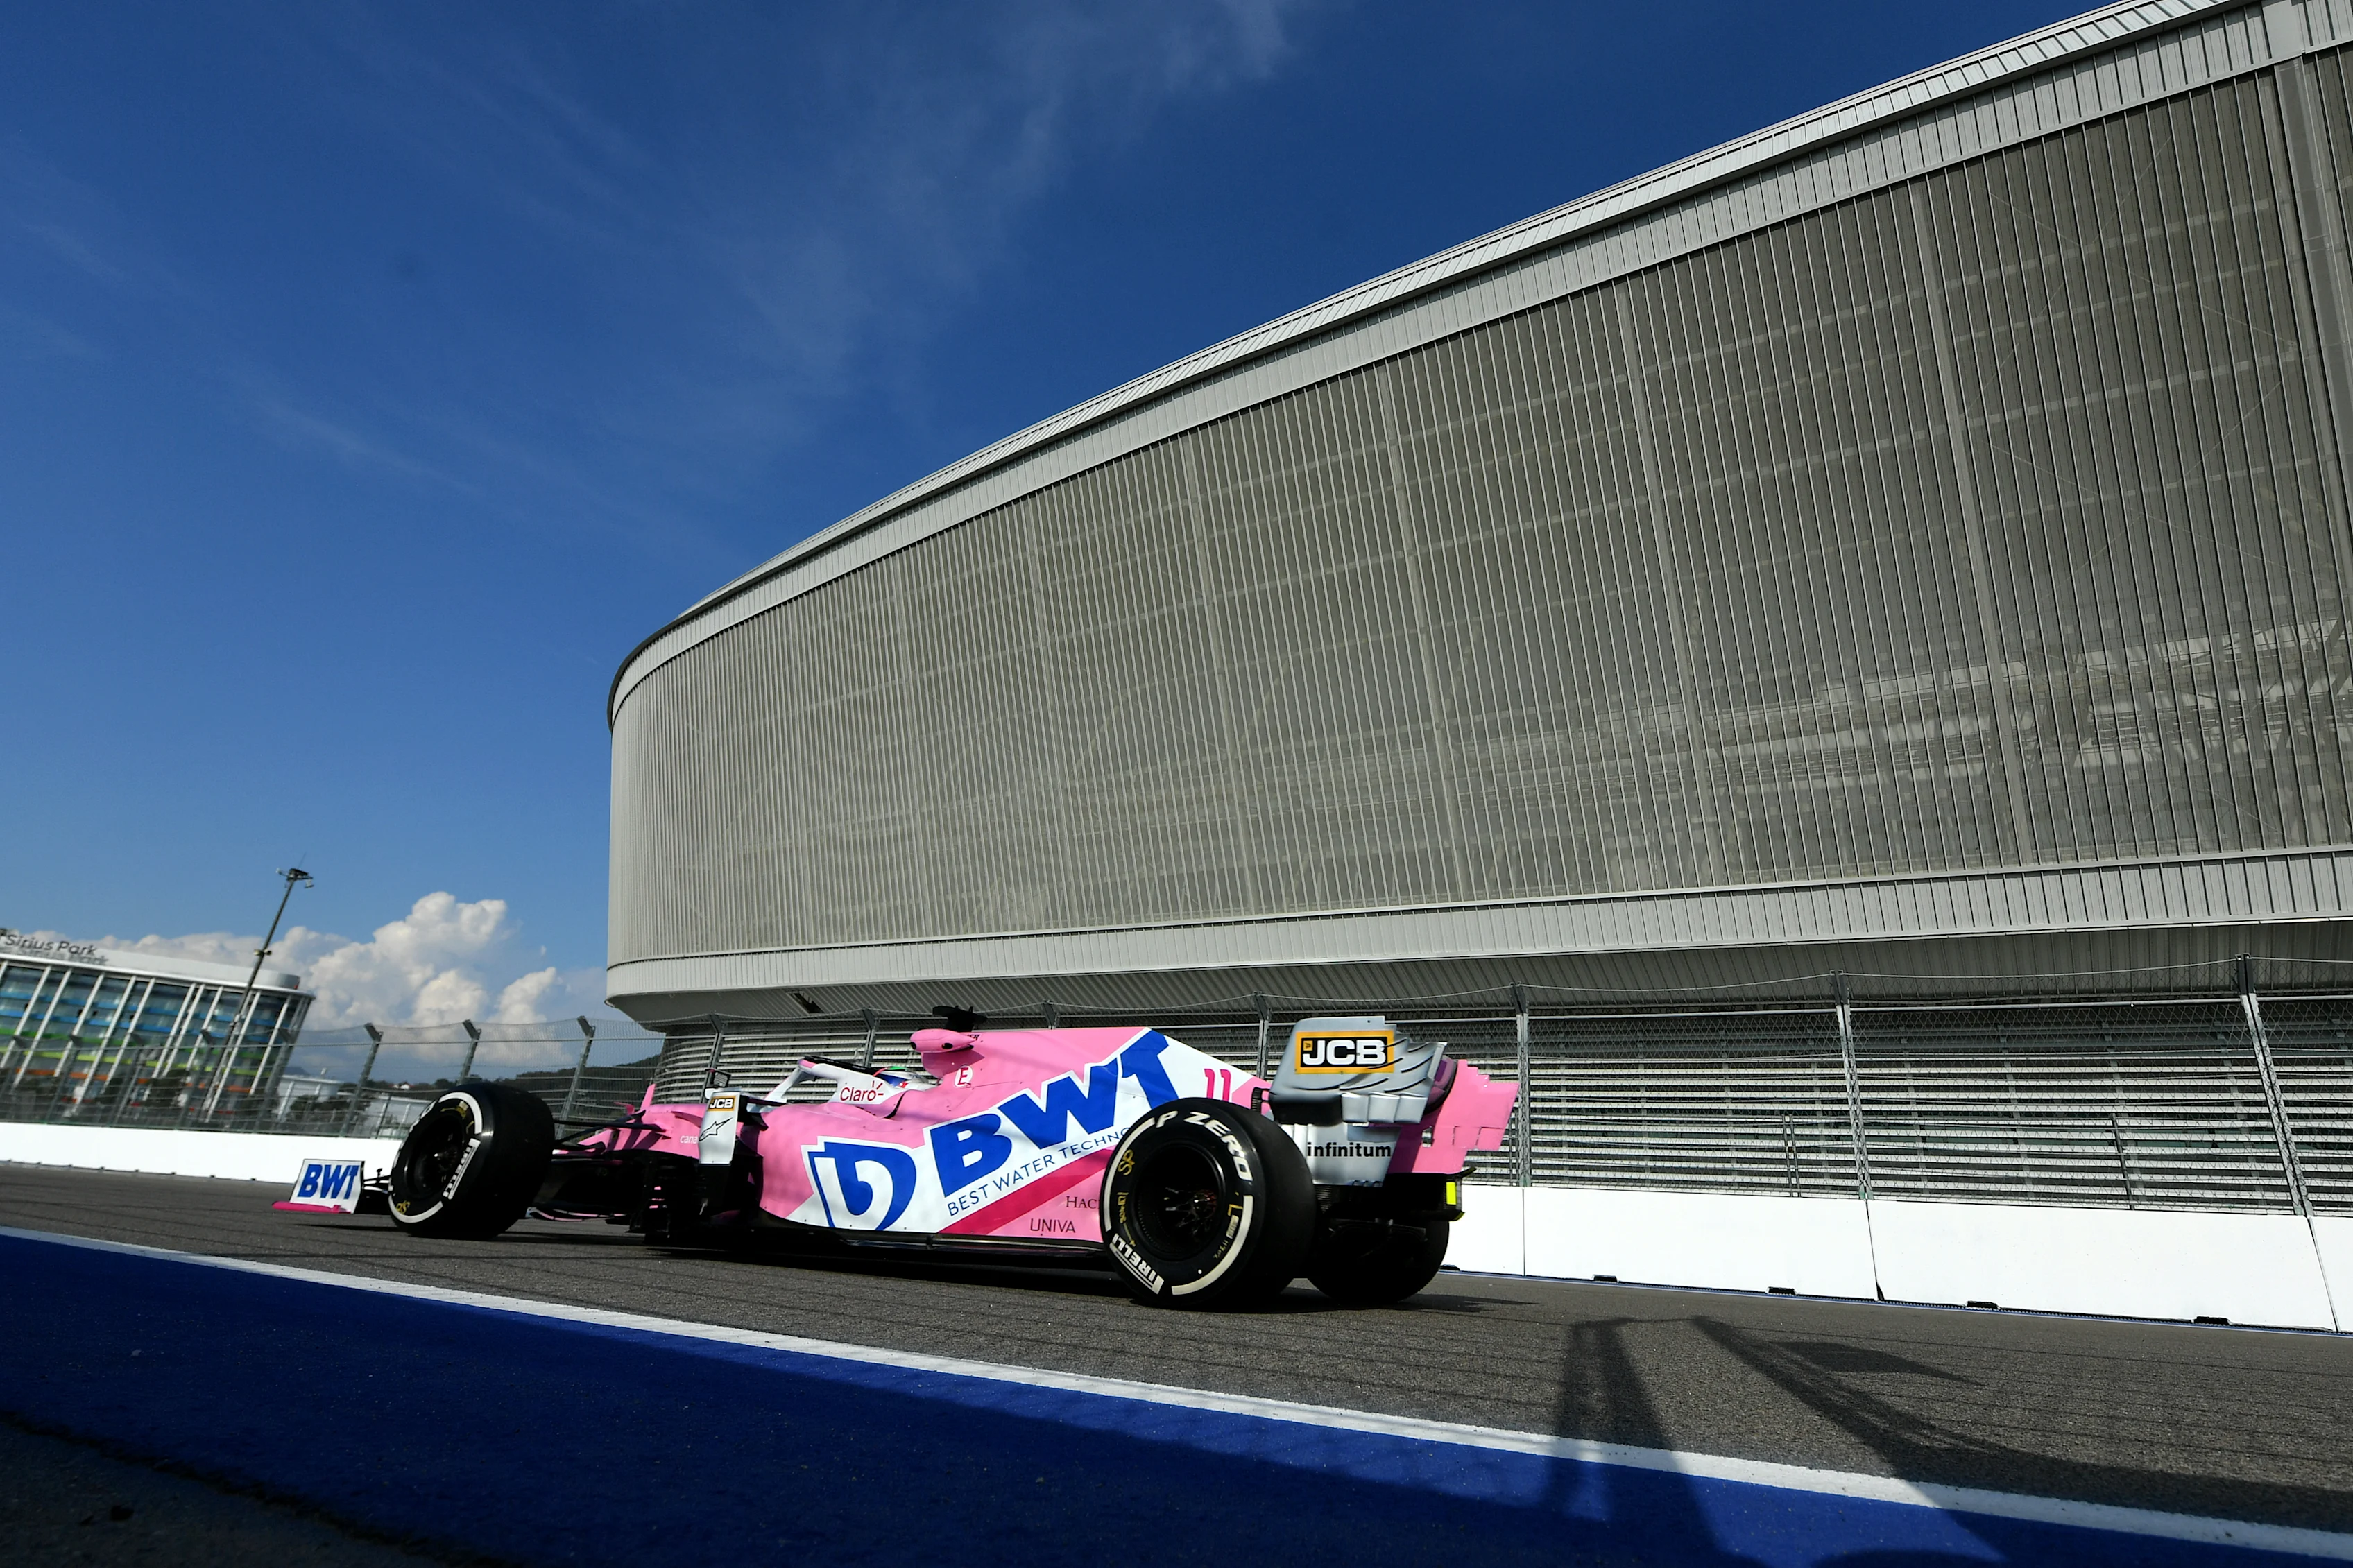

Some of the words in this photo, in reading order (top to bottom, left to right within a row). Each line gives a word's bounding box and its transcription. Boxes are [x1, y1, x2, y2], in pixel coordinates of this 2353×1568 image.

[6, 935, 53, 950] Sirius
[58, 940, 96, 956] Park
[1303, 1040, 1386, 1065] JCB
[957, 1067, 968, 1085] E
[1204, 1068, 1231, 1102] 11
[710, 1099, 734, 1108] JCB
[840, 1086, 876, 1101] Claro
[930, 1029, 1179, 1198] BWT
[1156, 1110, 1179, 1128] P
[1183, 1111, 1253, 1182] ZERO
[1308, 1141, 1392, 1157] infinitum
[297, 1164, 359, 1200] BWT
[948, 1184, 989, 1217] BEST
[993, 1154, 1056, 1191] WATER
[1066, 1196, 1100, 1209] HAC
[1030, 1218, 1075, 1233] UNIVA
[1110, 1233, 1164, 1294] PIRELLI
